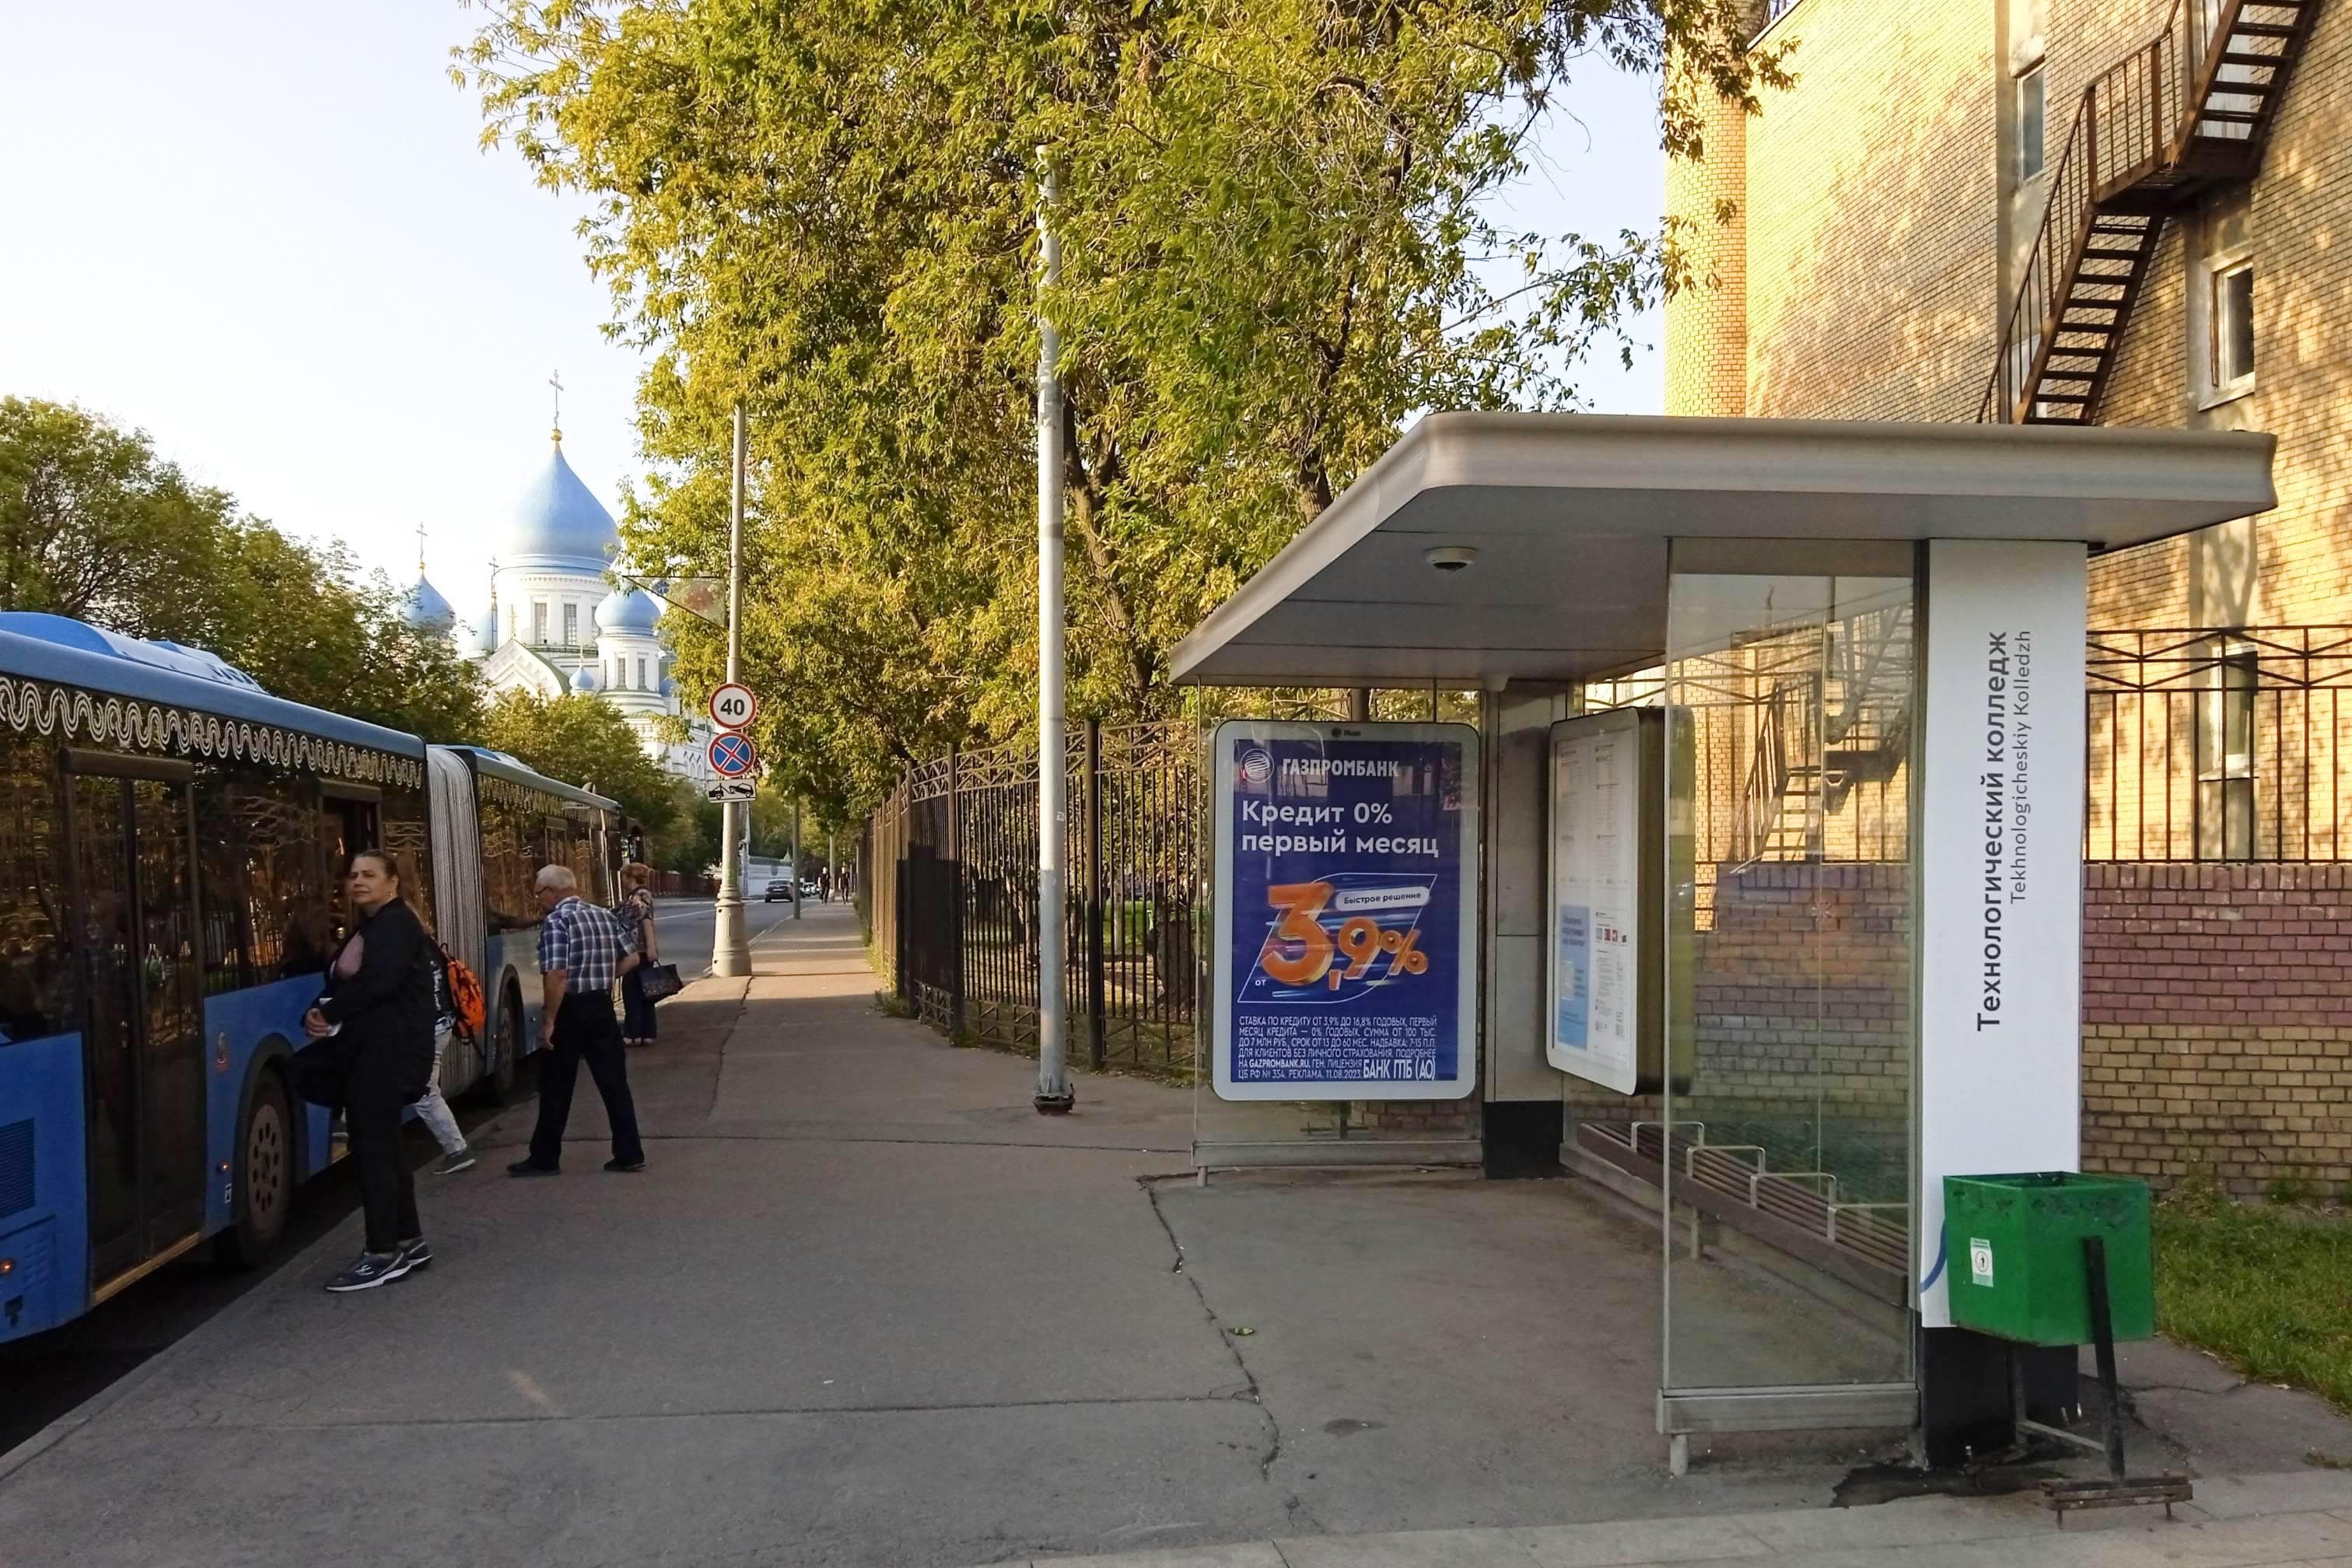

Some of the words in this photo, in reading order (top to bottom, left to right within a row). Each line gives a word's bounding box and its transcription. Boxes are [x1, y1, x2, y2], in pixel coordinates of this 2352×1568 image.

[2012, 631, 2032, 716] Kolledzh
[1987, 632, 2010, 762] колледж
[720, 698, 745, 716] 40
[1283, 758, 1400, 777] ГАЗПРОМБАНК
[1241, 800, 1345, 826] Кредит
[1354, 802, 1393, 824] 0%
[2011, 721, 2032, 905] Tekhnologicheskiy
[1241, 828, 1346, 856] первый
[1356, 836, 1439, 858] месяц
[1343, 896, 1381, 905] Быстрое
[1382, 893, 1422, 903] решение
[1977, 772, 2004, 1031] Технологический
[1261, 881, 1429, 991] 3,9%
[1239, 1016, 1266, 1026] СТАВКА
[1268, 1016, 1279, 1026] ПО
[1280, 1017, 1311, 1027] КРЕДИТУ
[1312, 1016, 1322, 1026] ОТ
[1340, 1017, 1351, 1027] ДО
[1409, 1015, 1437, 1027] ПЕРВЫЙ
[1239, 1027, 1264, 1037] МЕСЯЦ
[1266, 1027, 1297, 1037] КРЕДИТА
[1363, 1027, 1389, 1037] СУММА
[1392, 1027, 1402, 1037] ОТ
[1405, 1027, 1416, 1037] 100
[1420, 1027, 1437, 1037] ТЫС.
[1238, 1038, 1250, 1048] ДО
[1251, 1038, 1255, 1047] 7
[1256, 1038, 1272, 1047] МЛН
[1291, 1038, 1311, 1047] СРОК
[1311, 1038, 1321, 1047] ОТ
[1331, 1038, 1342, 1048] ДО
[1342, 1038, 1351, 1047] 60
[1238, 1048, 1253, 1058] ДЛЯ
[1255, 1048, 1292, 1058] КЛИЕНТОВ
[1293, 1048, 1306, 1058] БЕЗ
[1307, 1048, 1342, 1058] ЛИЧНОГО
[1395, 1048, 1437, 1059] ПОДРОБНЕЕ
[1238, 1059, 1248, 1068] НА
[1328, 1059, 1363, 1069] ЛИЦЕНЗИЯ
[1363, 1059, 1391, 1079] БАНК
[1415, 1057, 1436, 1080] (АО)
[1238, 1069, 1249, 1080] ЦБ
[1250, 1069, 1261, 1079] РФ
